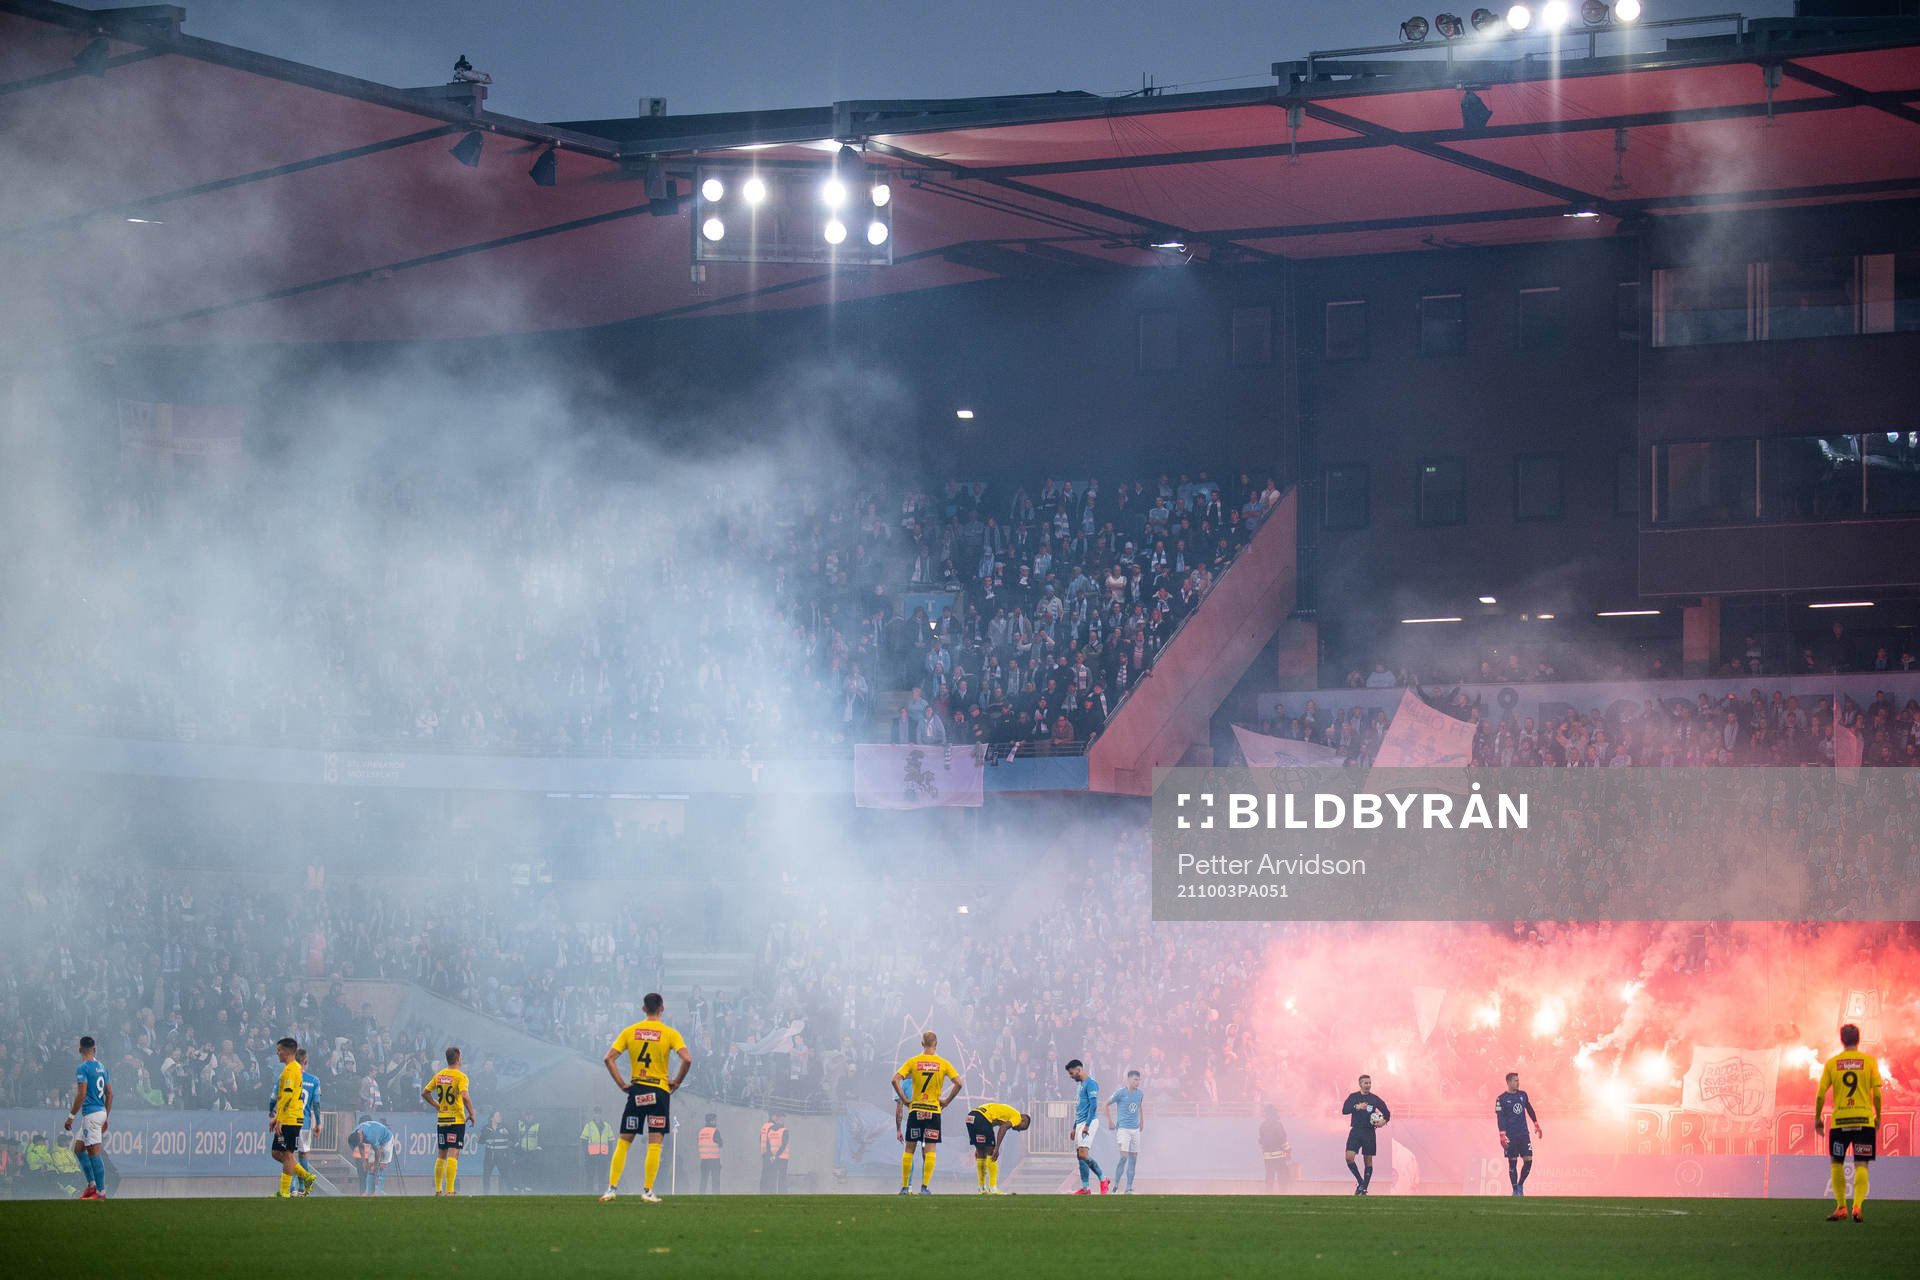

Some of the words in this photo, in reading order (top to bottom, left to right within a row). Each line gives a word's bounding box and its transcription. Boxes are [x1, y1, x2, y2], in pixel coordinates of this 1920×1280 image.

[637, 1042, 652, 1068] 4
[96, 1076, 105, 1098] 9
[921, 1072, 934, 1093] 7
[1842, 1071, 1858, 1098] 9
[436, 1085, 456, 1105] 96
[103, 1131, 143, 1155] 2004
[151, 1131, 186, 1155] 2010
[195, 1131, 227, 1155] 2013
[234, 1131, 266, 1155] 2014
